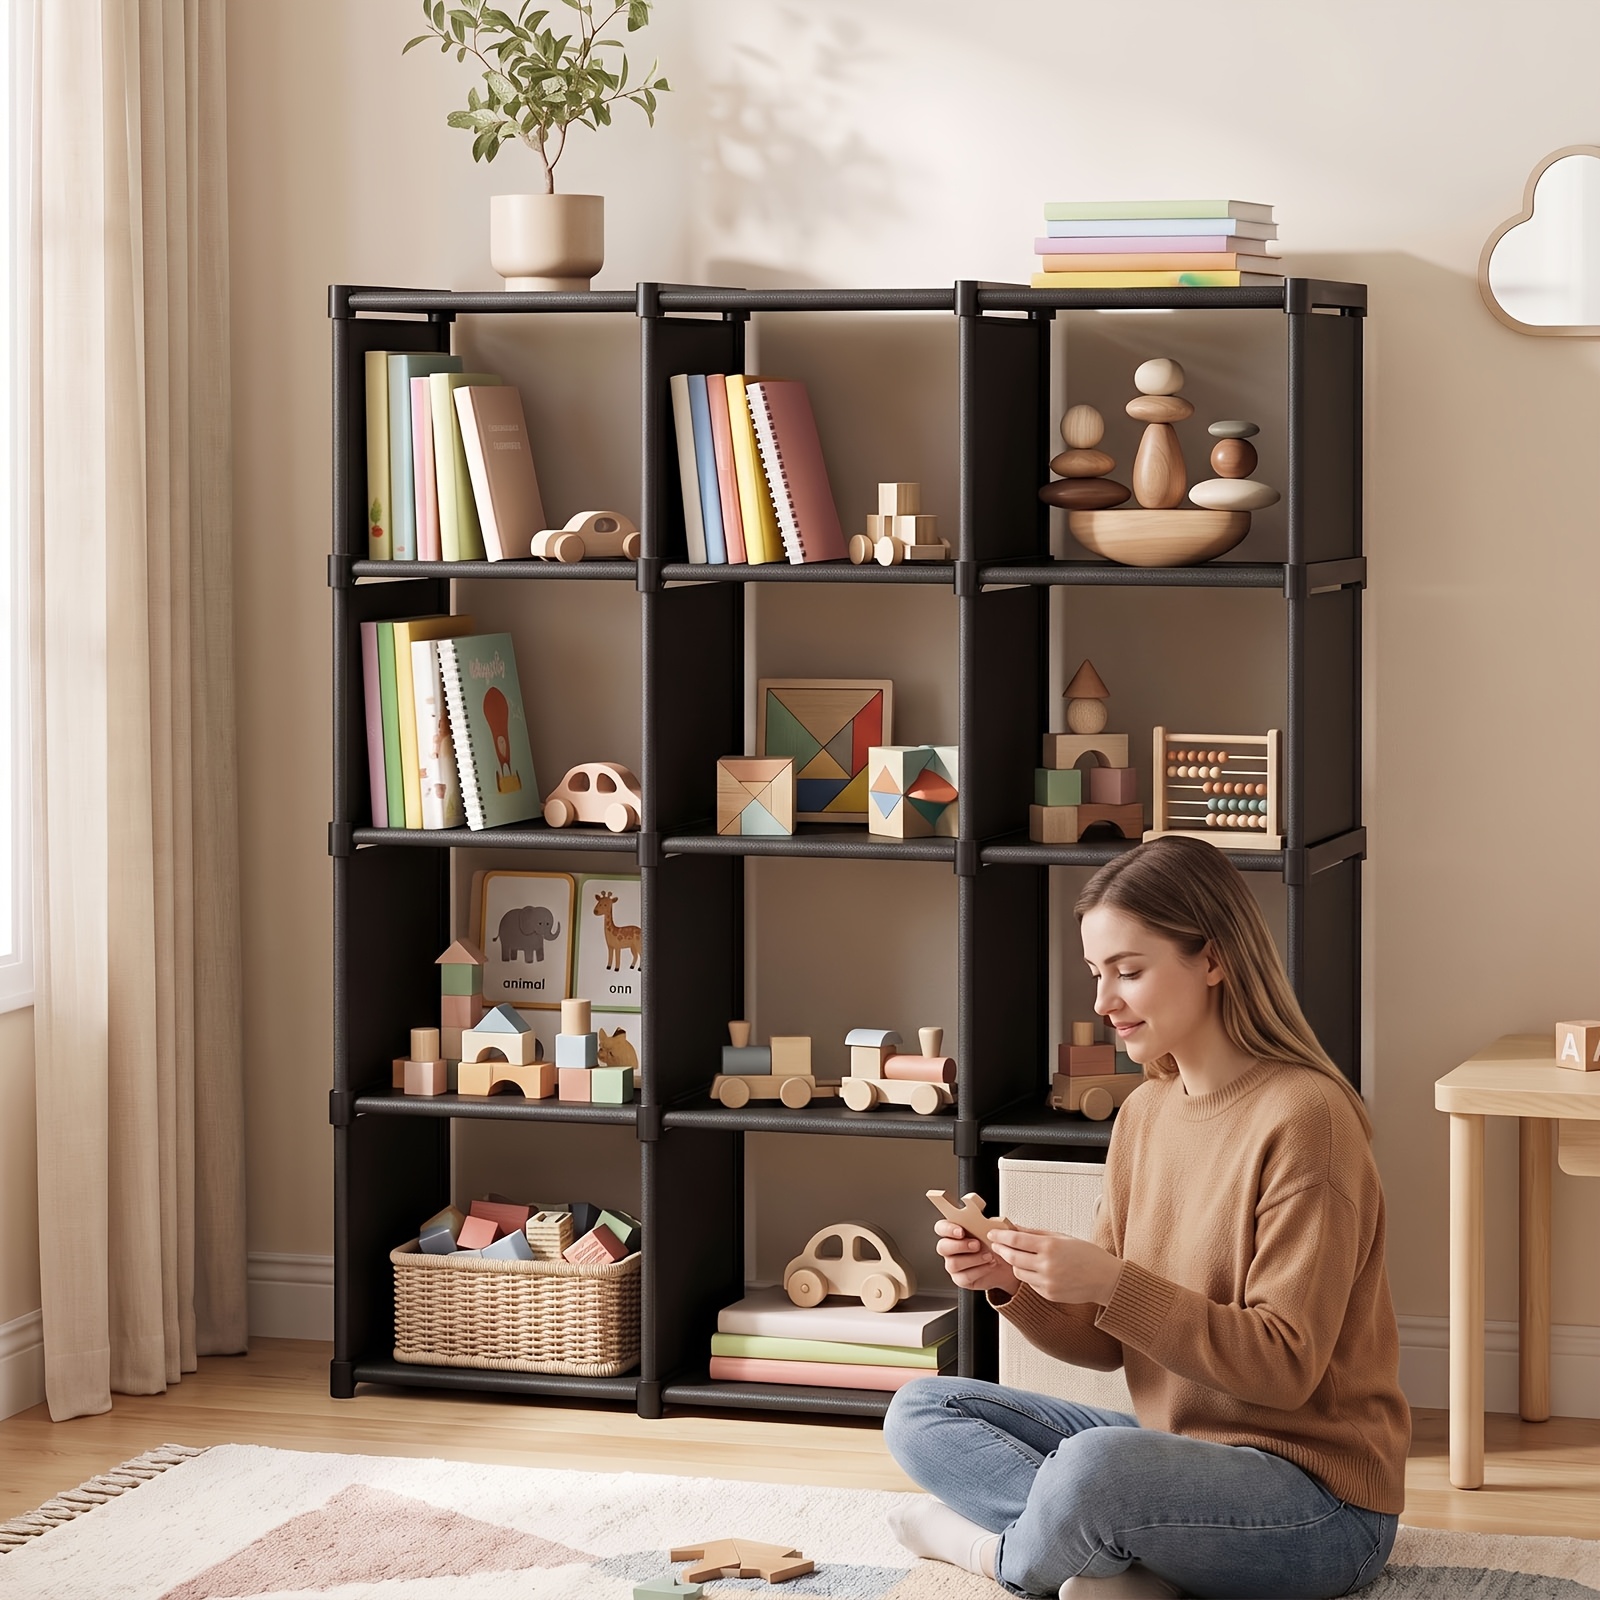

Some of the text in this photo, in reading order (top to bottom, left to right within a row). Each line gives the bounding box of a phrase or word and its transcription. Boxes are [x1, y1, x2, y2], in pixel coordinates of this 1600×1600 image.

[503, 978, 545, 990] animal
[609, 984, 632, 994] onn
[1561, 1032, 1580, 1063] A
